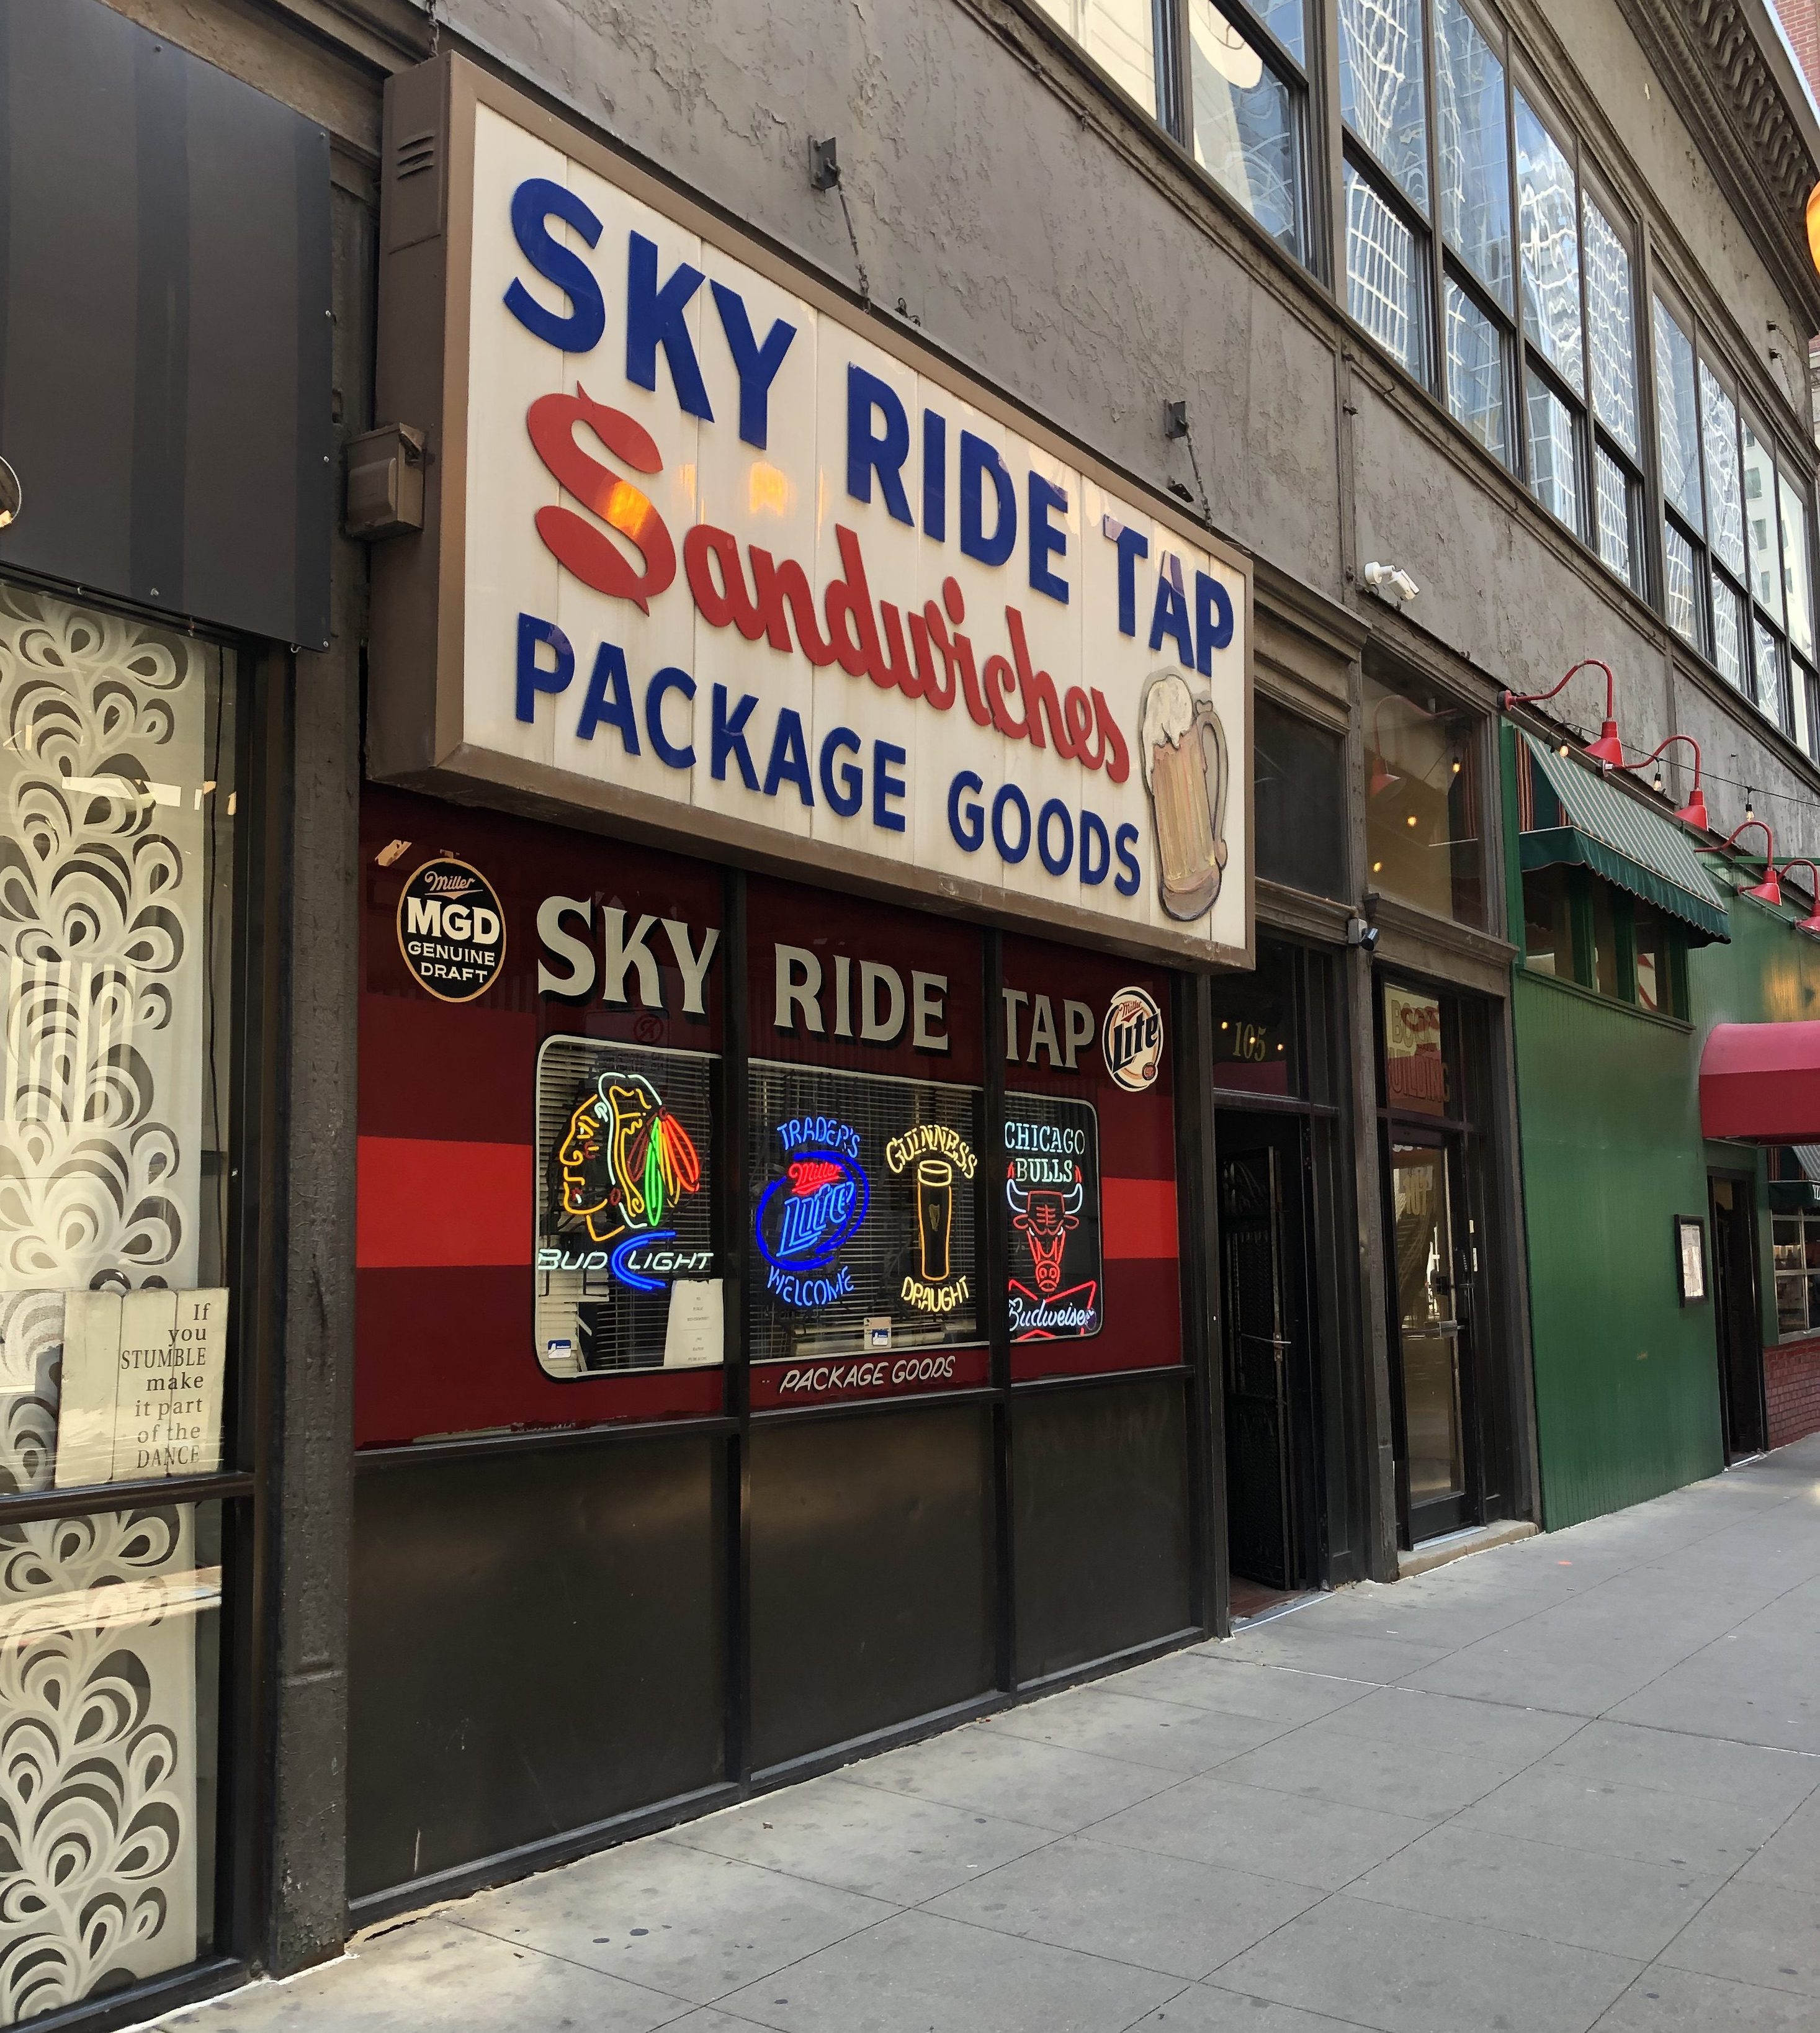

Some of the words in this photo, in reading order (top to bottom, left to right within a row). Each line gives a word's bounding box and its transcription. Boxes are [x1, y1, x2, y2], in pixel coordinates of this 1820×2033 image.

[503, 177, 797, 451] SKY
[846, 361, 1072, 604] RIDE
[1102, 513, 1234, 677] TAP
[526, 380, 1130, 785] Sandwiches
[515, 612, 907, 833] PACKAGE
[948, 770, 1141, 897] GOODS
[424, 871, 475, 891] Miller
[406, 896, 500, 945] MGD
[408, 942, 495, 967] GENUINE
[420, 962, 488, 983] DRAFT
[537, 895, 721, 1015] SKY
[774, 943, 948, 1051] RIDE
[1002, 988, 1095, 1069] TAP
[1113, 1012, 1159, 1074] Lite
[1232, 1021, 1267, 1062] 105
[776, 1116, 860, 1159] TRADER'S
[886, 1124, 978, 1179] GUINNESS
[1005, 1121, 1085, 1155] CHICAGO
[788, 1162, 842, 1187] Miller
[1015, 1157, 1073, 1183] BULLS
[776, 1181, 854, 1257] Lite
[537, 1248, 609, 1270] BUD
[627, 1250, 714, 1270] LIGHT
[767, 1265, 854, 1306] WELCOME
[900, 1275, 969, 1313] DRAUGHT
[193, 1303, 212, 1321] If
[1008, 1297, 1095, 1332] Budweiser
[168, 1327, 207, 1347] you
[120, 1347, 207, 1370] STUMBLE
[779, 1362, 889, 1394] PACKAGE
[892, 1355, 956, 1384] GOODS
[146, 1373, 204, 1392] make
[135, 1400, 151, 1417] it
[158, 1398, 204, 1419] part
[137, 1424, 160, 1443] of
[167, 1423, 200, 1441] the
[137, 1445, 200, 1469] DANCE
